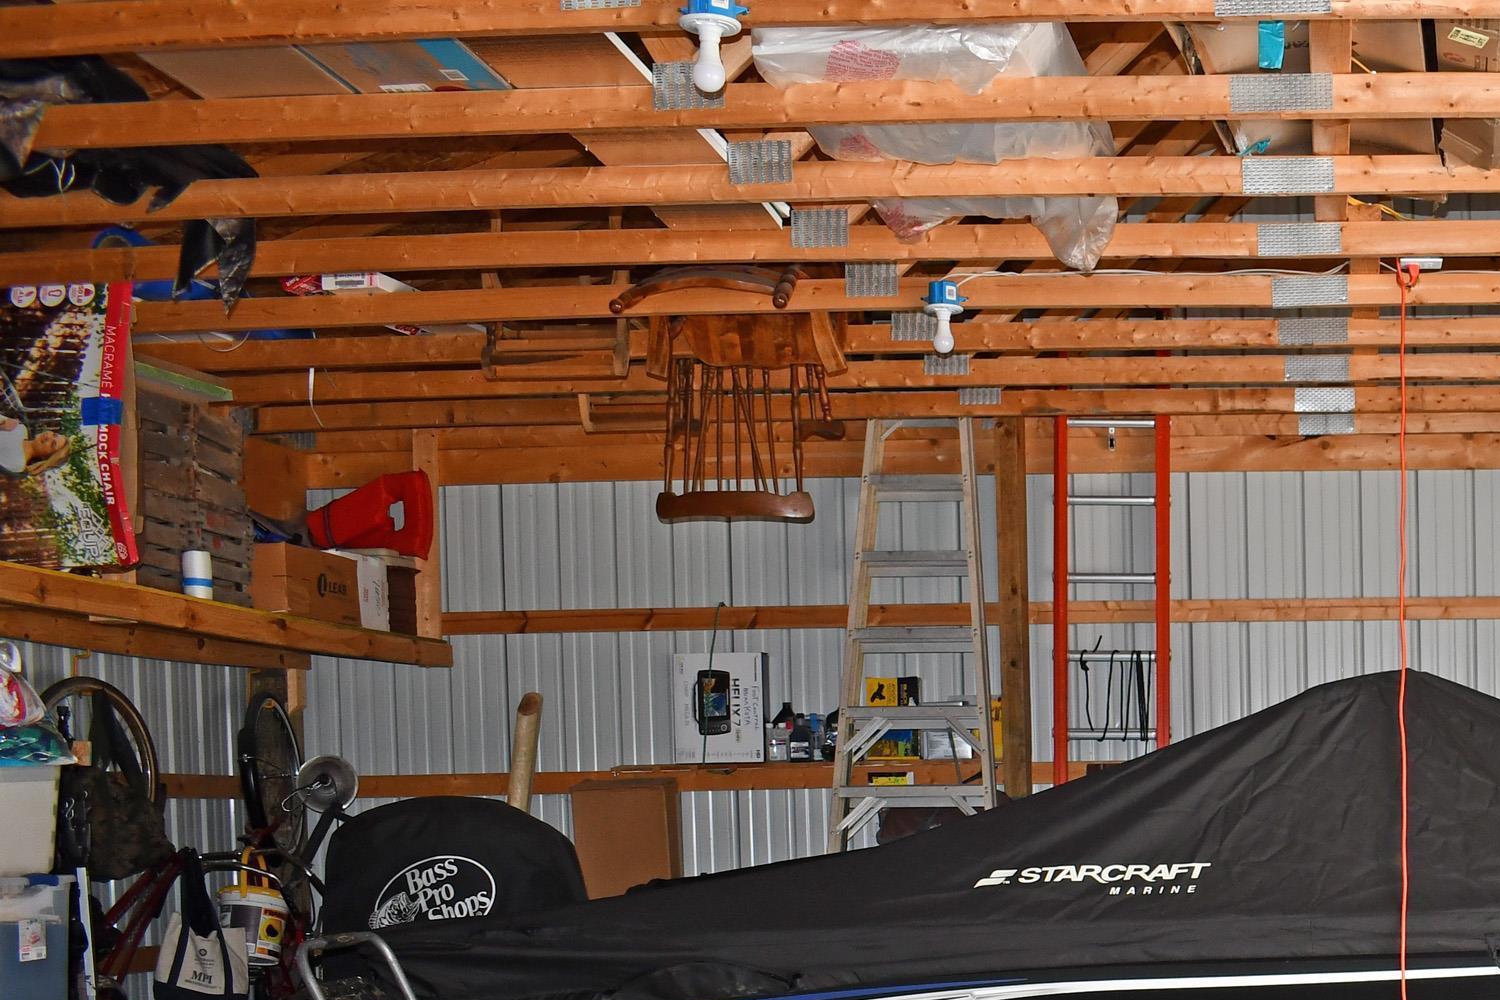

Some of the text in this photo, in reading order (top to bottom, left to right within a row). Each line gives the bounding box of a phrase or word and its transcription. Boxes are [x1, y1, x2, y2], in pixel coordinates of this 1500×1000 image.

[100, 463, 116, 505] CHAIR
[405, 859, 458, 895] Bass
[1018, 862, 1211, 884] STARCRAFT
[417, 883, 455, 913] Pro
[1109, 885, 1197, 895] MARINE
[428, 891, 491, 920] Shops
[190, 969, 213, 986] MPI
